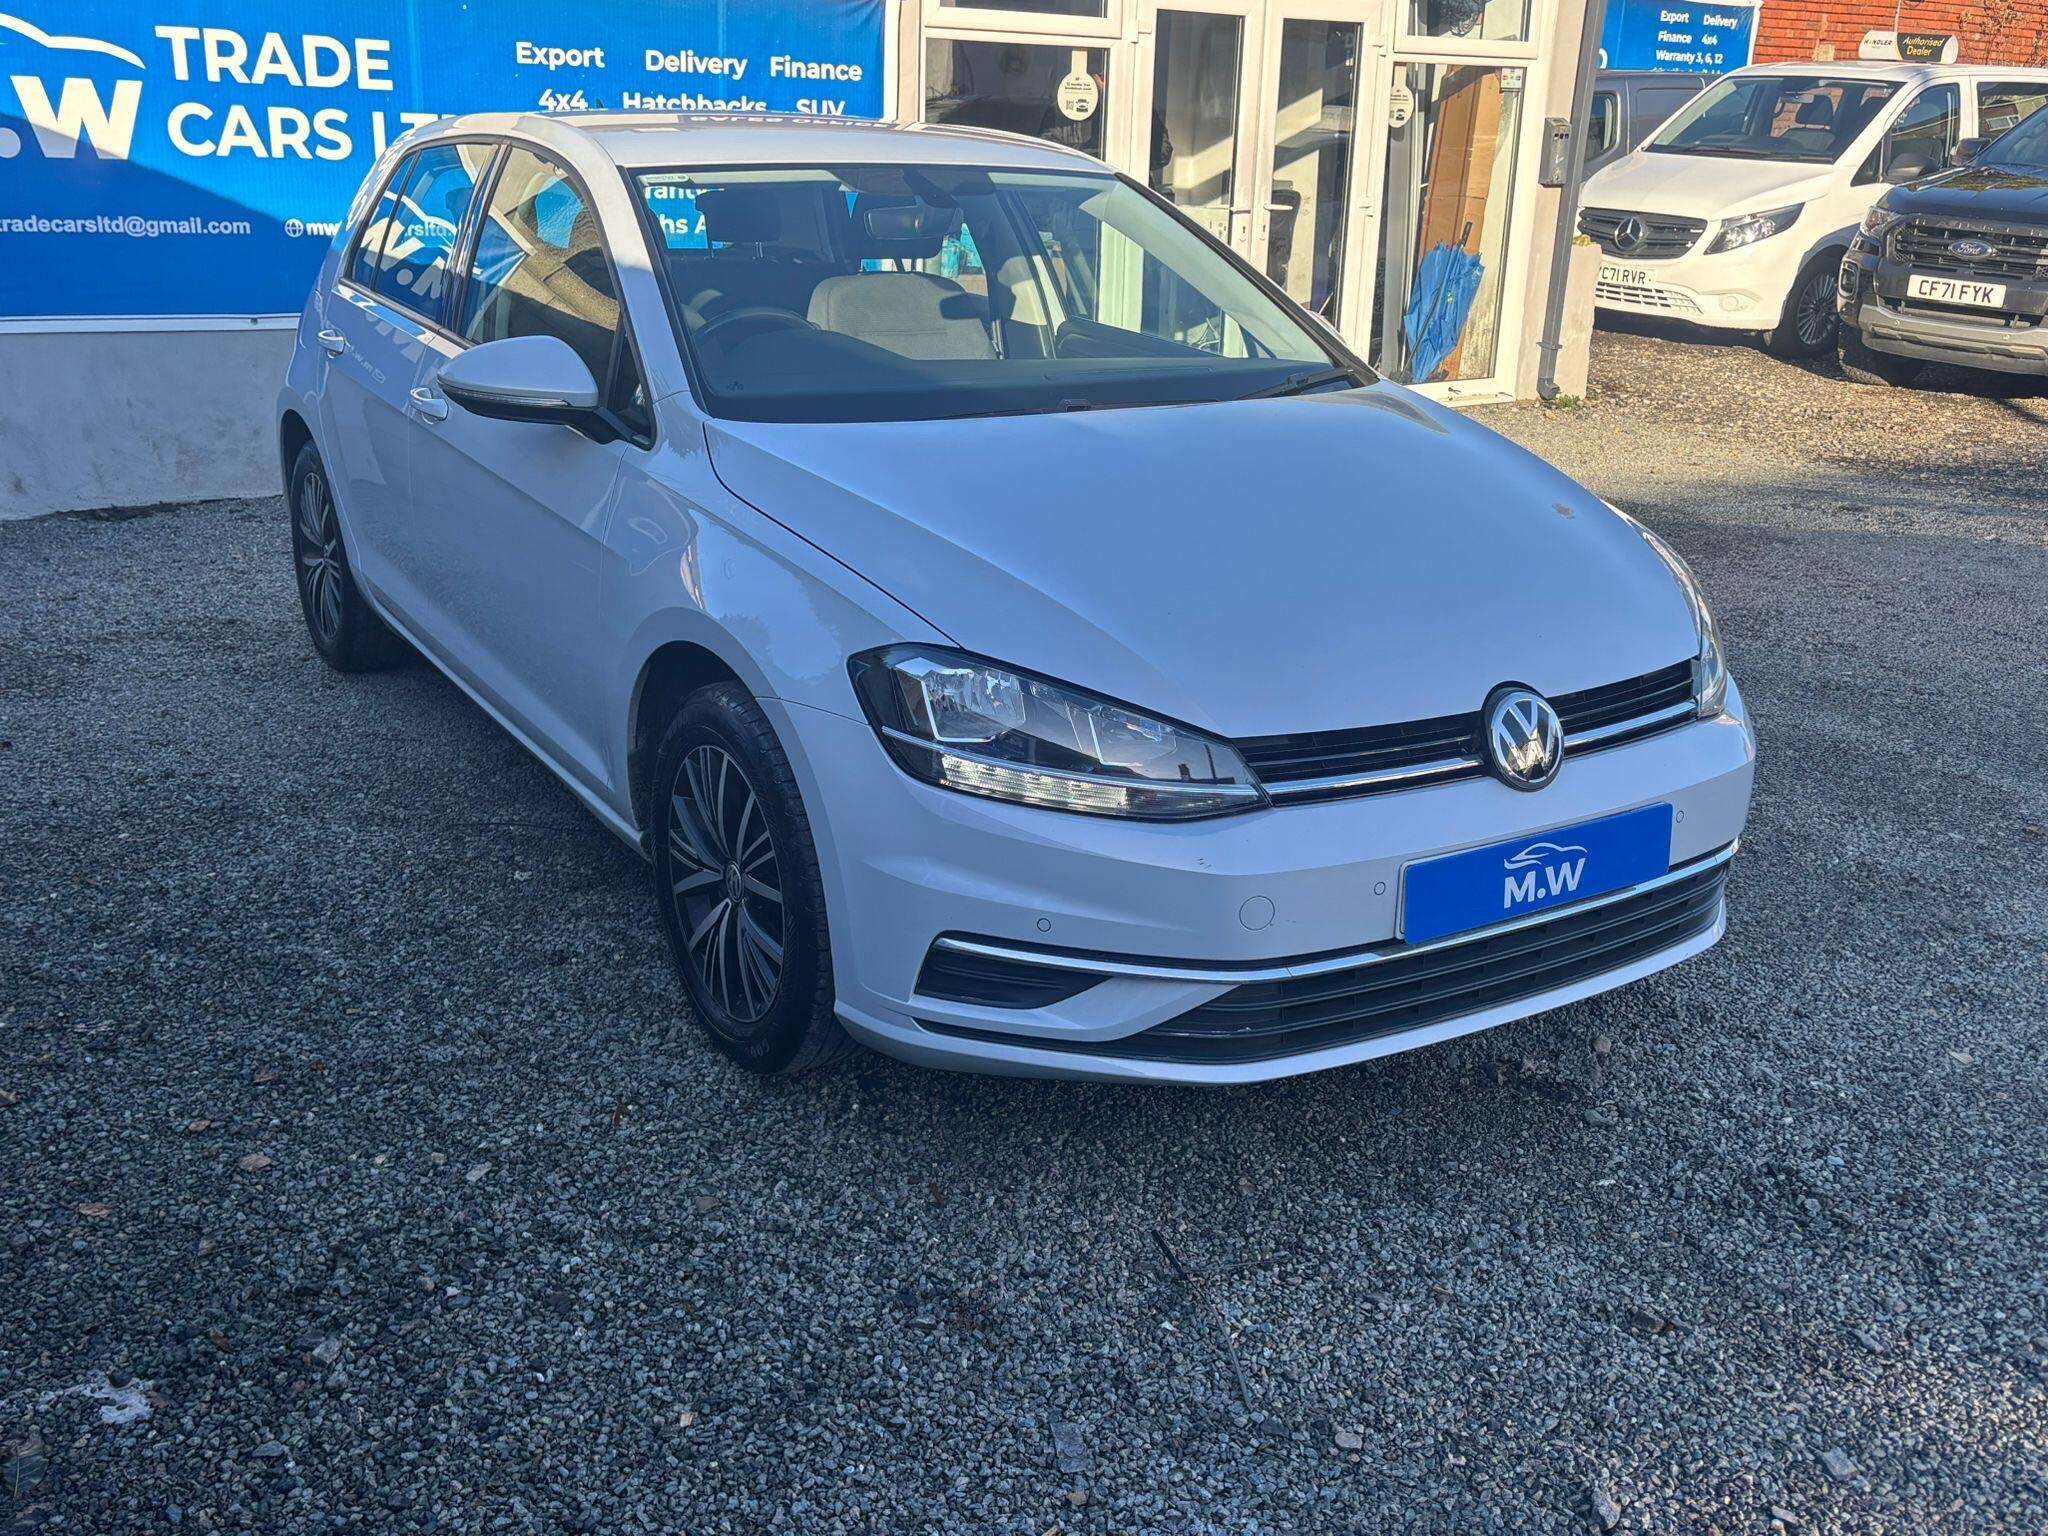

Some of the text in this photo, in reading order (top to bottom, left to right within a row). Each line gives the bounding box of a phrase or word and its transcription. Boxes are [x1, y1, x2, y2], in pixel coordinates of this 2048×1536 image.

[1660, 10, 1738, 30] Export Delivery
[1657, 30, 1693, 44] Finance
[1903, 36, 1946, 47] Authorised
[154, 25, 394, 91] TRADE
[1655, 49, 1695, 64] Warranty
[1906, 45, 1932, 56] Dealer
[515, 41, 864, 82] Export Delivery Finance
[538, 88, 846, 116] 4x4 Hatchbacks SUV
[168, 102, 353, 161] CARS
[1599, 266, 1646, 285] C71 RVR
[1919, 280, 1994, 303] CF71 FYK
[1503, 857, 1587, 909] M.W
